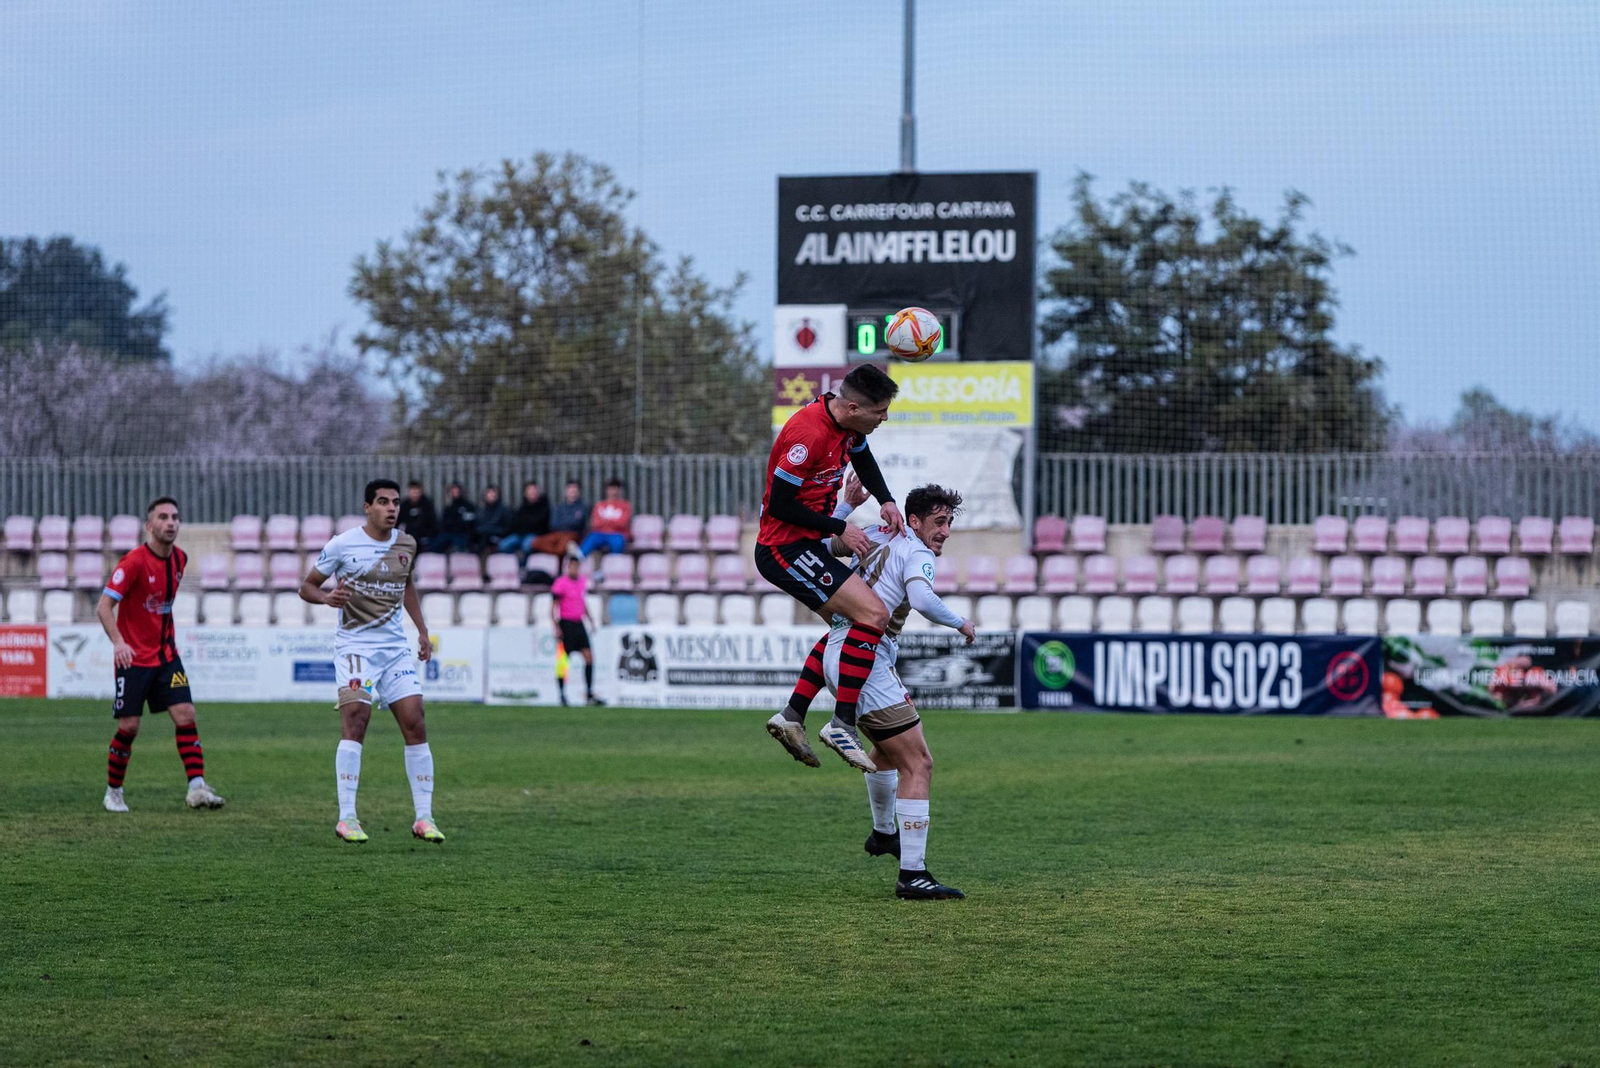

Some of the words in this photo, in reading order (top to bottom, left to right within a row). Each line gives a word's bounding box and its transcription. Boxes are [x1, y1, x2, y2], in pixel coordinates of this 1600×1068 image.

[829, 202, 934, 221] CARREFOUR
[936, 200, 1016, 219] CARTAYA
[858, 324, 876, 355] 0
[898, 369, 1021, 403] ASESORÍA
[794, 550, 825, 578] 14
[665, 631, 741, 663] MESÓN
[746, 636, 777, 663] LA
[346, 653, 361, 674] 11
[1092, 641, 1304, 709] IMPULSO23
[1526, 667, 1599, 687] ANDALUCÍA
[117, 677, 126, 698] 3
